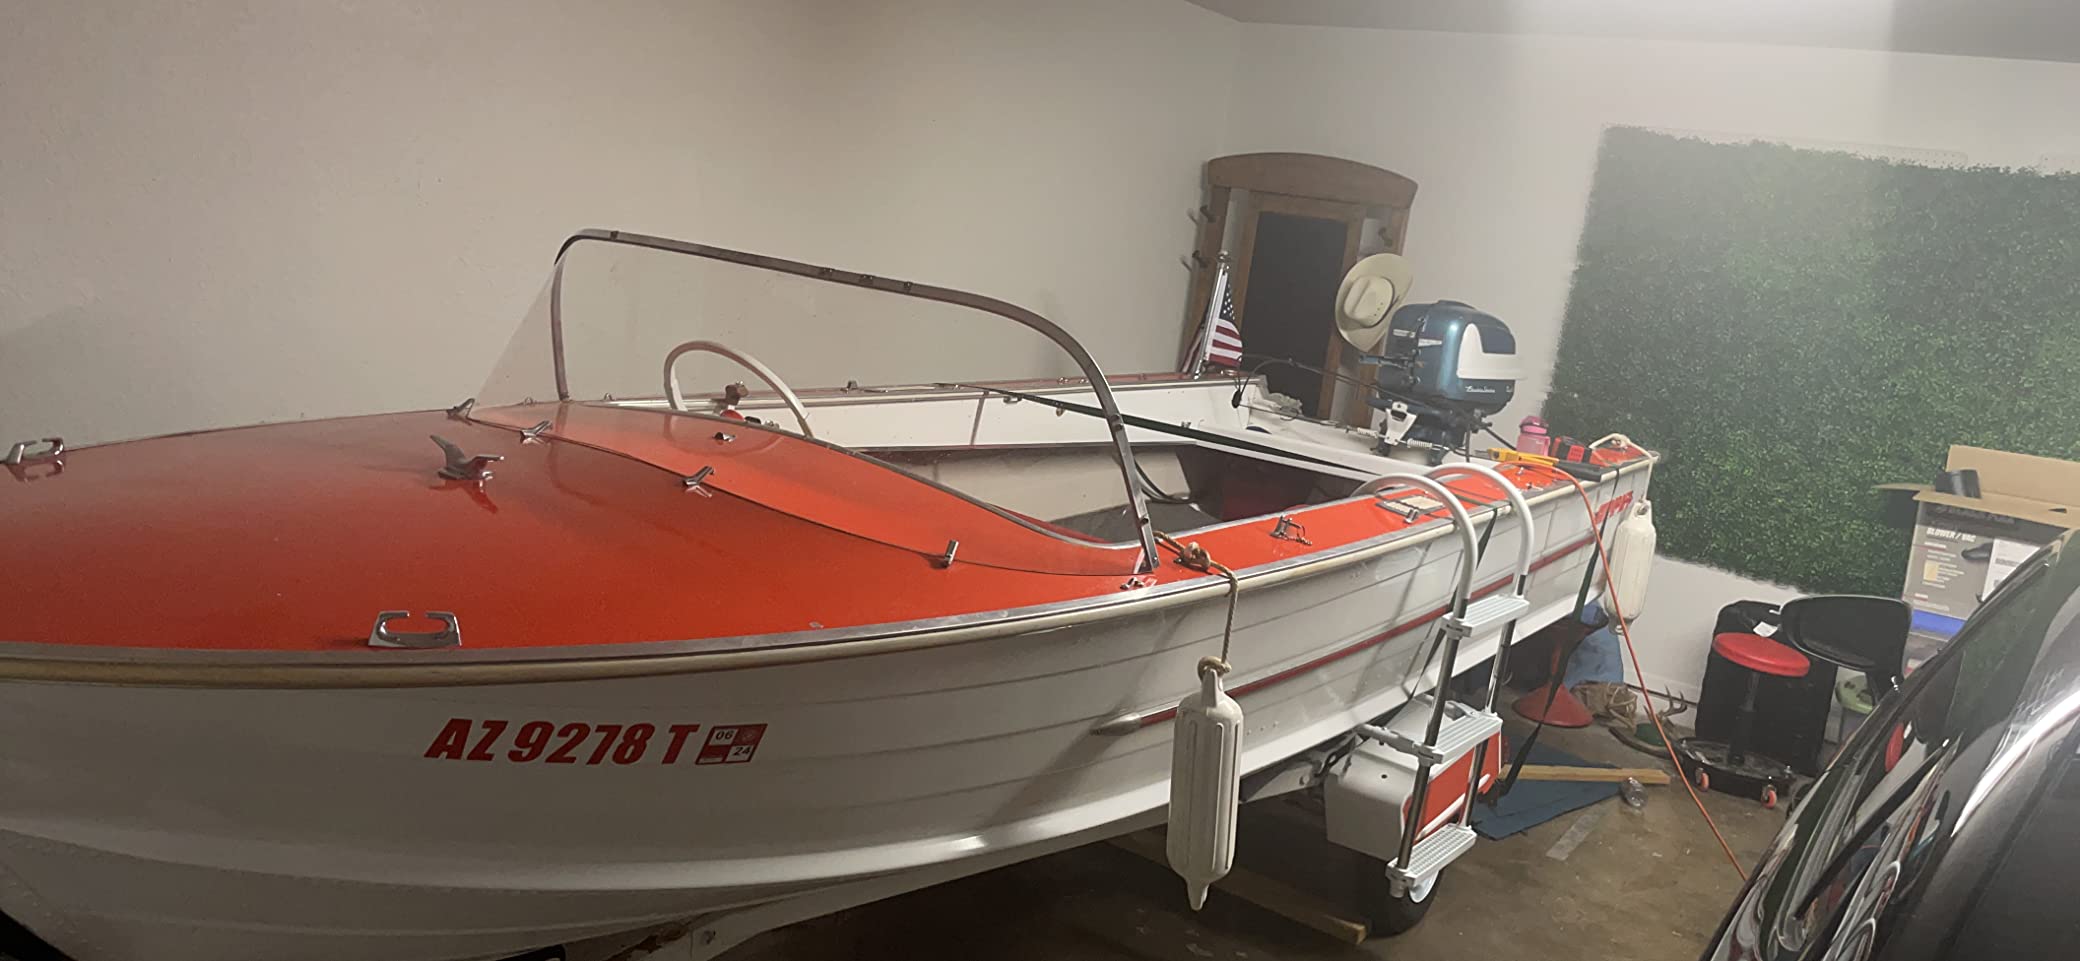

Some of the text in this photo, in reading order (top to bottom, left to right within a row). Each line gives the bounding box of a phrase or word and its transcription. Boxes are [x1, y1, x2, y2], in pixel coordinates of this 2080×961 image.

[715, 730, 735, 740] 06
[424, 718, 700, 765] AZ 9278 T
[733, 746, 751, 756] 24
